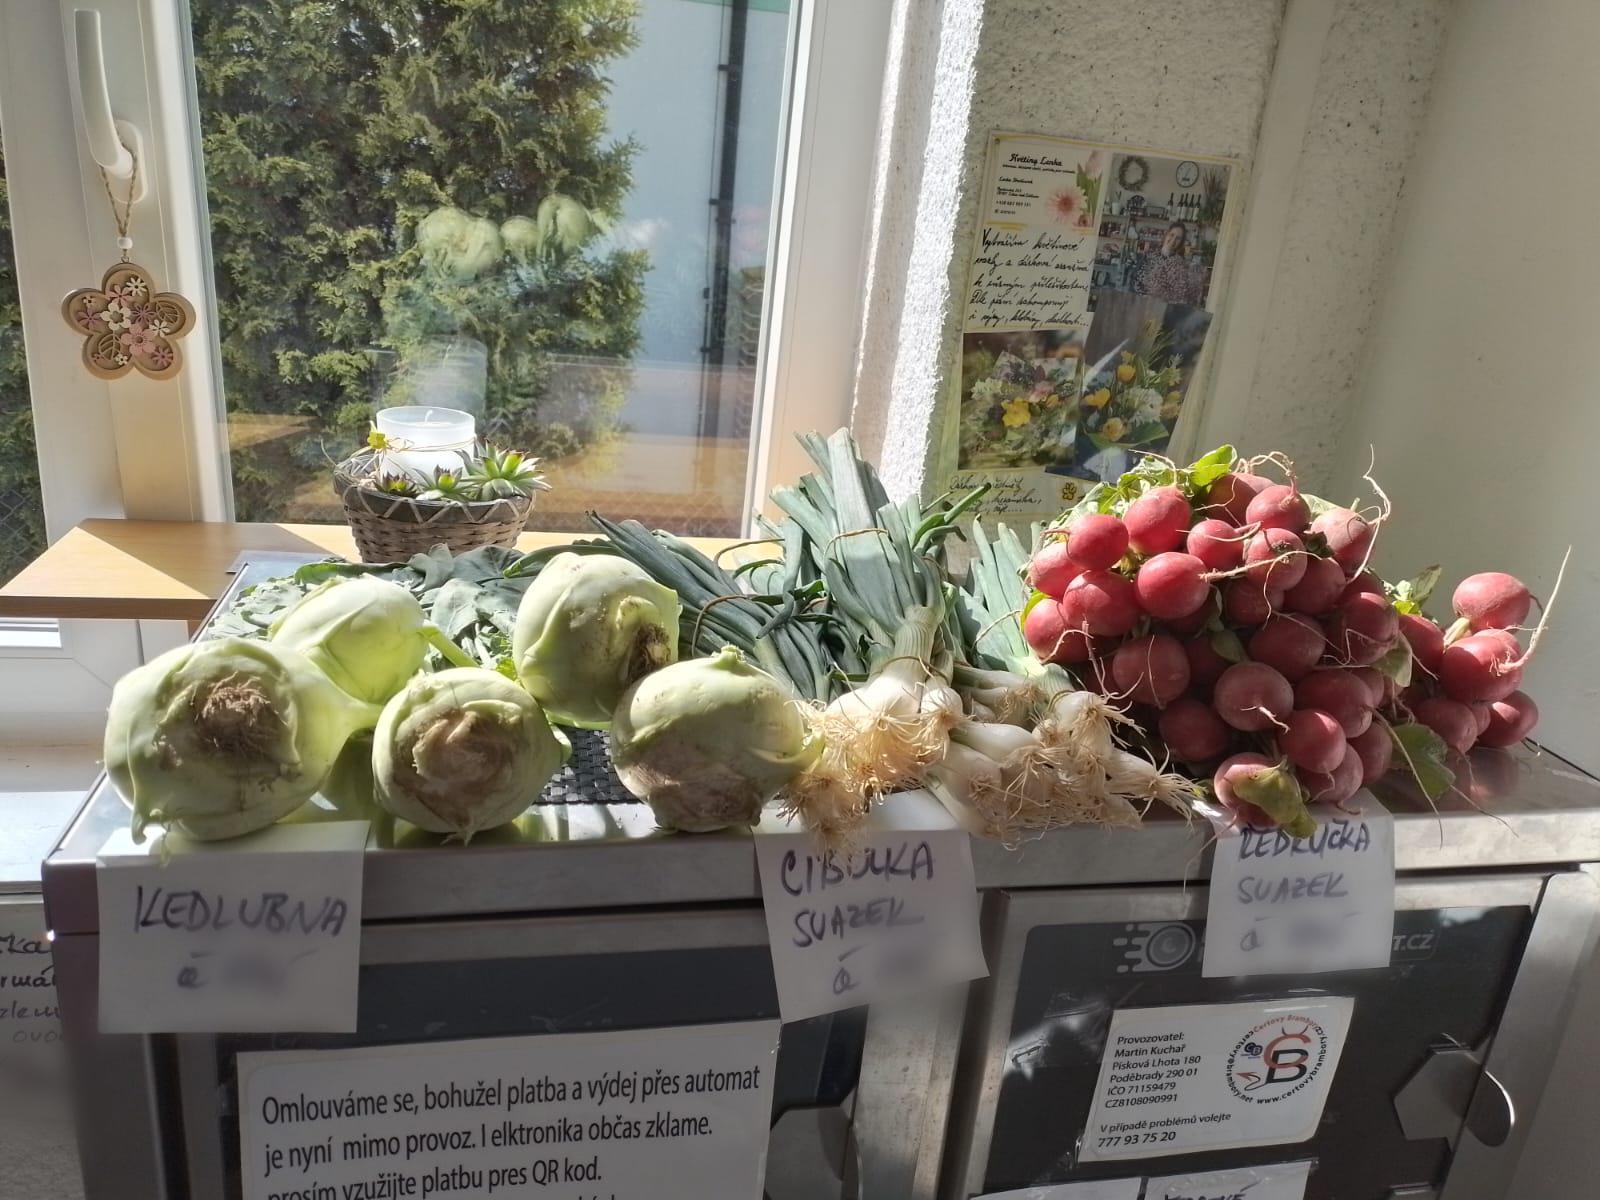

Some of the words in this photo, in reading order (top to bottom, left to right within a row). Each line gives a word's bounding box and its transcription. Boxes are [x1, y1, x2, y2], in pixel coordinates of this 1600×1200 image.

[134, 885, 347, 936] KEDLUBNA
[1117, 1032, 1185, 1045] Provozovatel:
[1114, 1047, 1148, 1058] Martin
[1150, 1044, 1186, 1056] Kuchař
[1112, 1059, 1150, 1071] Písková
[1152, 1057, 1180, 1068] Lhota
[1183, 1055, 1201, 1065] 180
[1110, 1070, 1164, 1083] Poděbrady
[1166, 1069, 1184, 1079] 290
[1186, 1068, 1198, 1077] 01
[262, 1089, 388, 1125] Omlouváme
[393, 1093, 419, 1115] se,
[424, 1078, 502, 1111] bohužel
[507, 1076, 567, 1112] platba
[572, 1080, 583, 1100] a
[588, 1070, 638, 1106] výdej
[641, 1069, 680, 1103] přes
[684, 1065, 761, 1094] automat
[1107, 1084, 1126, 1096] IČO
[1128, 1082, 1176, 1095] 71159479
[1105, 1094, 1178, 1108] CZ8108090991
[1101, 1124, 1108, 1133] V
[1109, 1120, 1147, 1133] případě
[1149, 1115, 1197, 1130] problémů
[1199, 1113, 1232, 1124] volejte
[264, 1144, 284, 1178] je
[289, 1136, 332, 1173] nyní
[343, 1134, 400, 1161] mimo
[406, 1129, 476, 1160] provoz.
[491, 1117, 583, 1147] elktronika
[588, 1114, 641, 1141] občas
[645, 1111, 713, 1138] zklame.
[1098, 1136, 1121, 1147] 777
[1124, 1134, 1139, 1145] 93
[1142, 1133, 1157, 1143] 75
[1160, 1131, 1177, 1142] 20
[422, 1164, 483, 1199] platbu
[488, 1165, 527, 1193] pres
[532, 1159, 559, 1186] QR
[564, 1155, 602, 1182] kod.
